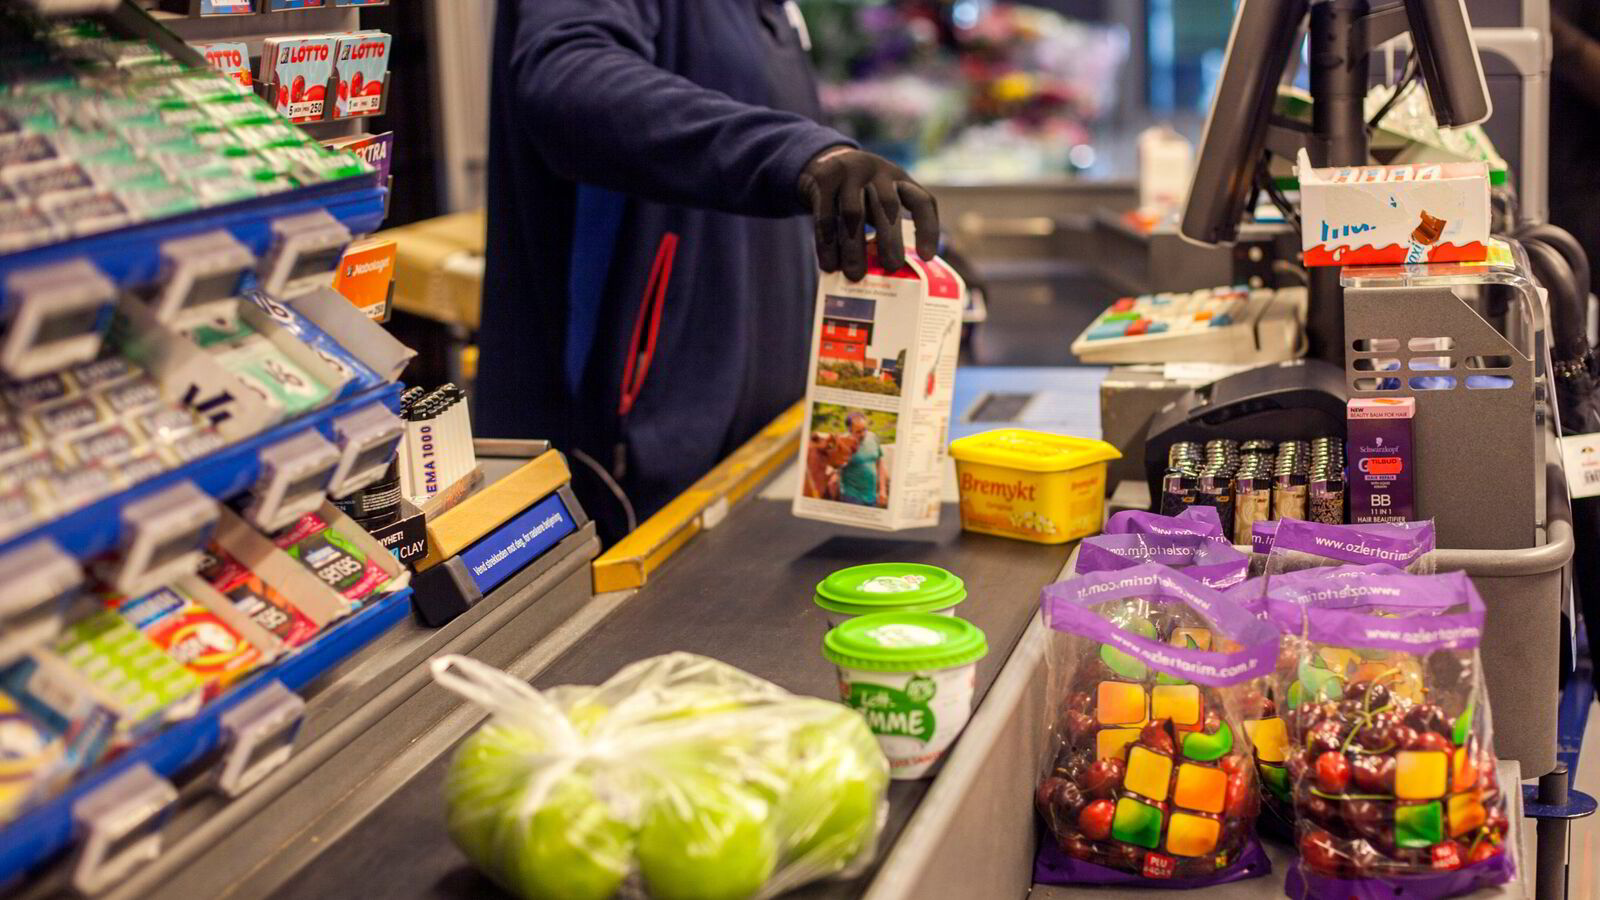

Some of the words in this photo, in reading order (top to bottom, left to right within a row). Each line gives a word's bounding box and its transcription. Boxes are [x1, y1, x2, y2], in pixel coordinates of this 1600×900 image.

[206, 50, 242, 68] OTTO
[291, 44, 328, 63] LOTTO
[352, 41, 385, 60] LOTTO
[289, 105, 294, 116] 5
[310, 102, 323, 114] 250
[420, 426, 434, 458] 1000
[1360, 445, 1399, 454] Schwarzkopf
[424, 461, 438, 494] EMA
[961, 472, 1036, 502] Bremykt
[1370, 494, 1391, 506] BB
[400, 540, 424, 559] CLAY
[473, 561, 488, 576] Vend
[506, 542, 518, 554] mot
[521, 533, 530, 543] for
[866, 709, 925, 735] MME
